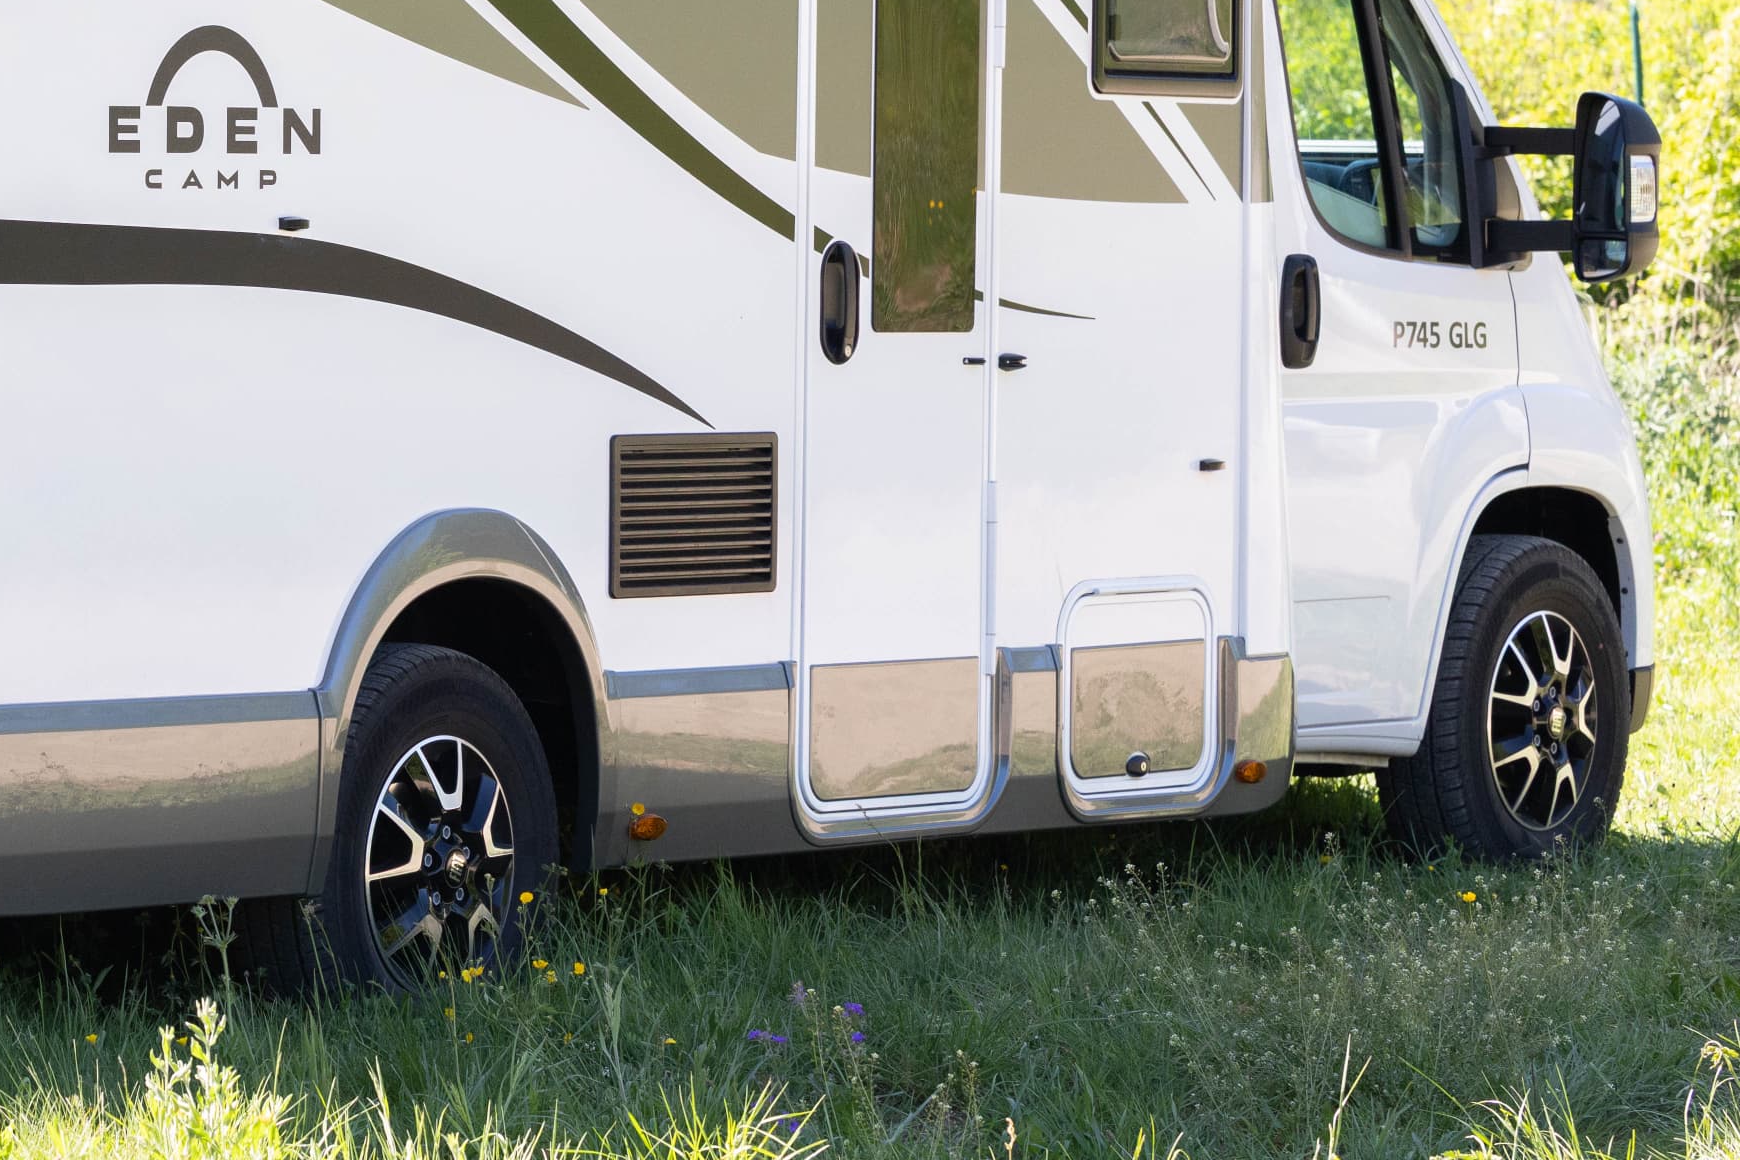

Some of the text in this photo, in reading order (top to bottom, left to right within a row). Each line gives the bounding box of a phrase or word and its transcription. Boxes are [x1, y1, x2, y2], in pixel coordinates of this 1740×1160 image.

[108, 105, 321, 155] EDEN
[144, 168, 277, 190] CAMP
[1393, 321, 1487, 349] P745 GLG
